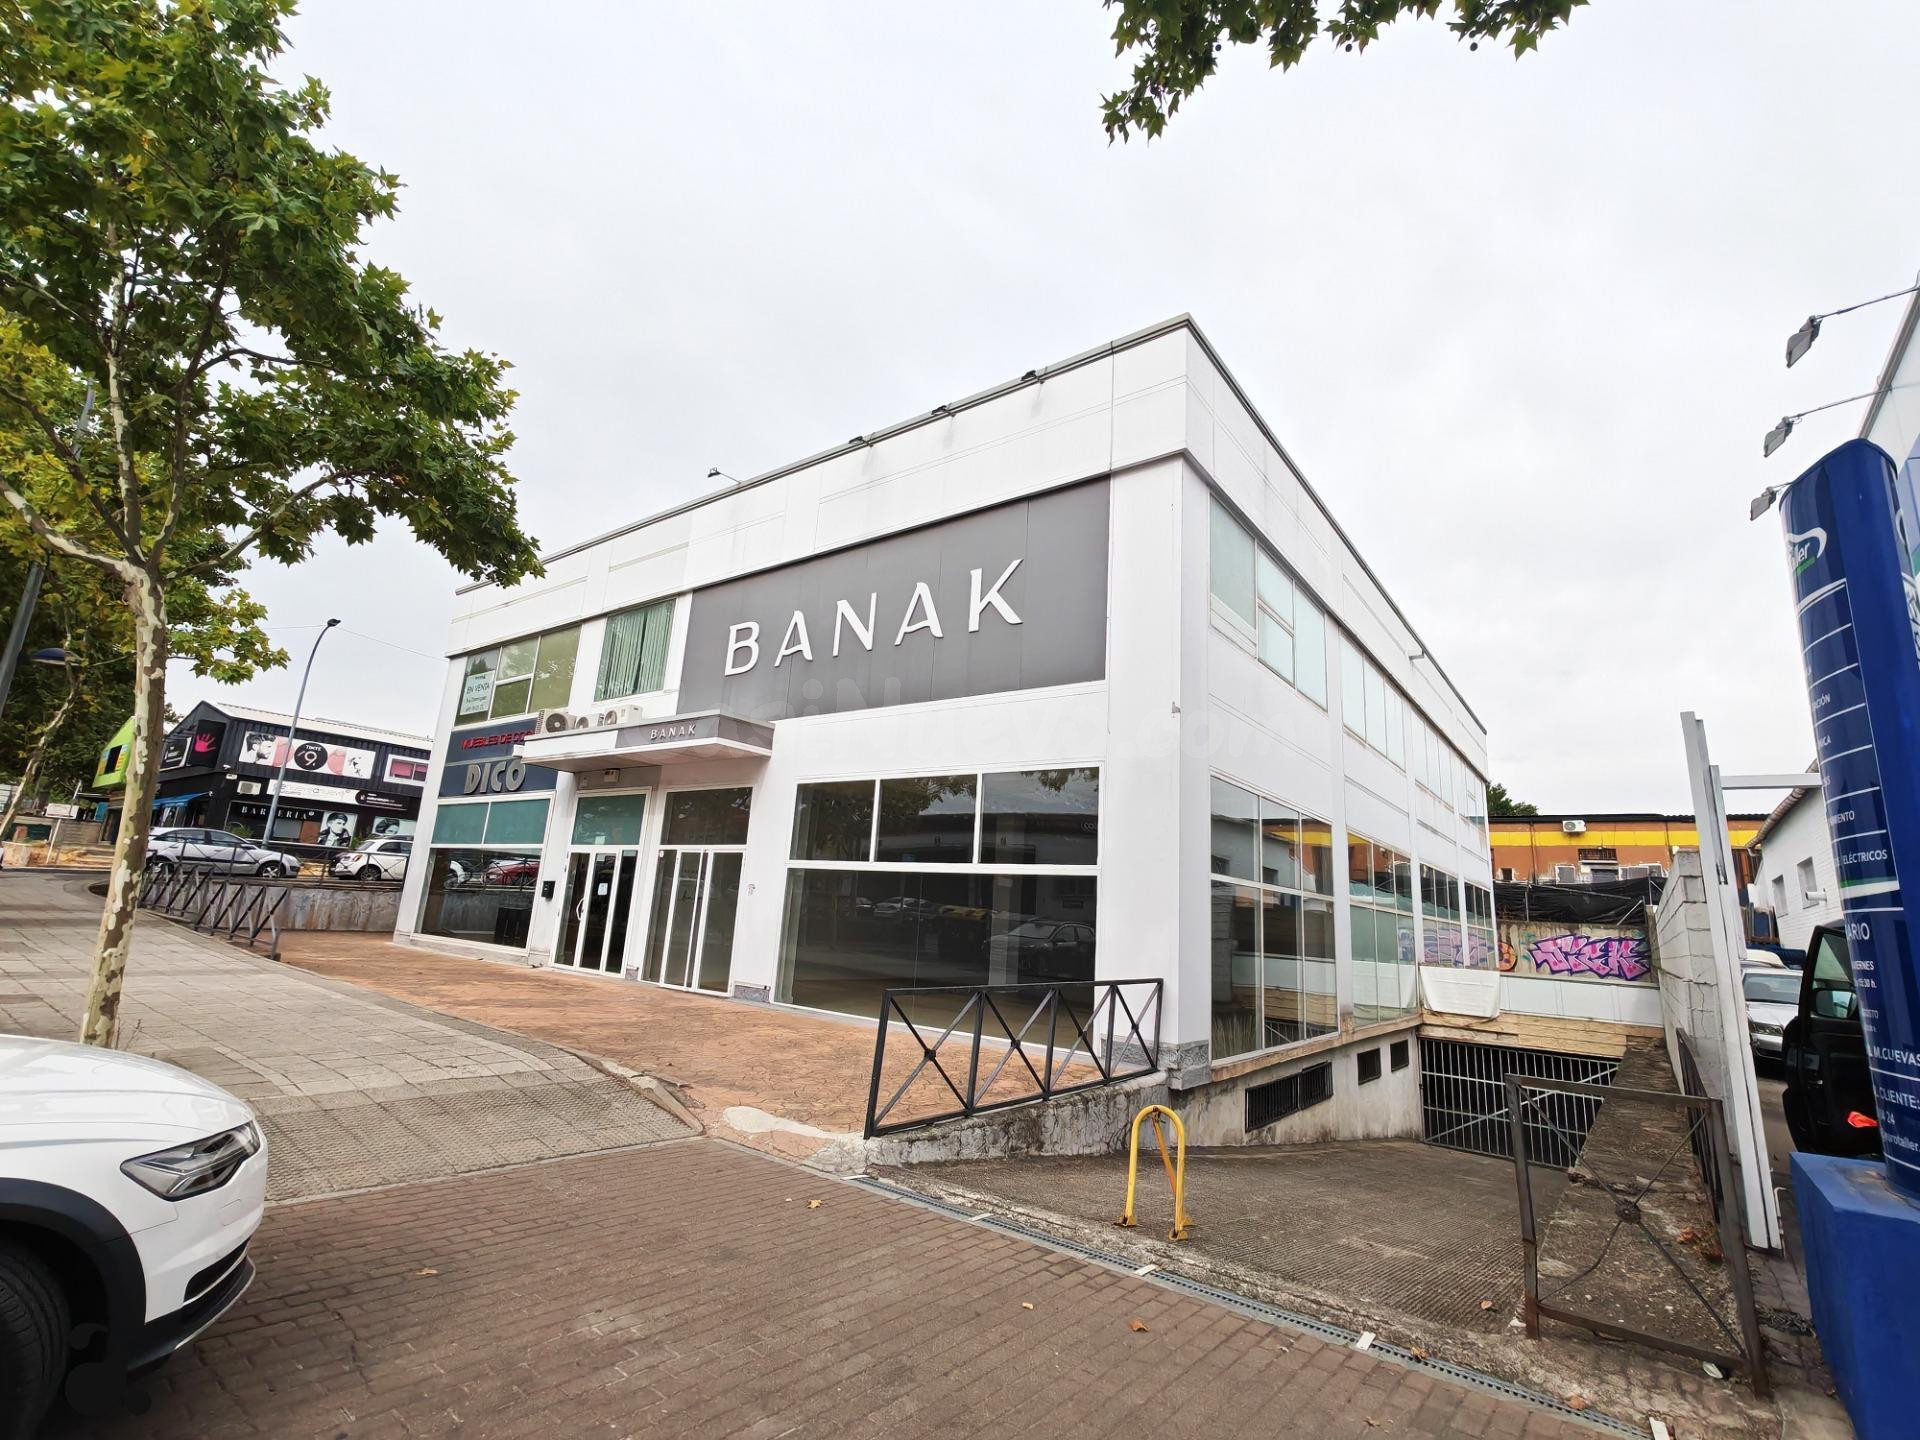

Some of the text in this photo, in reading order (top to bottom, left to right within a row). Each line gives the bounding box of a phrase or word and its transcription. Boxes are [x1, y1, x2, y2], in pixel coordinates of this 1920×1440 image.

[724, 558, 1024, 677] BANAK
[650, 724, 697, 740] BANAK
[464, 760, 526, 794] DICO
[241, 805, 307, 820] BARERIA
[1842, 849, 1888, 865] ELÉCTRICOS
